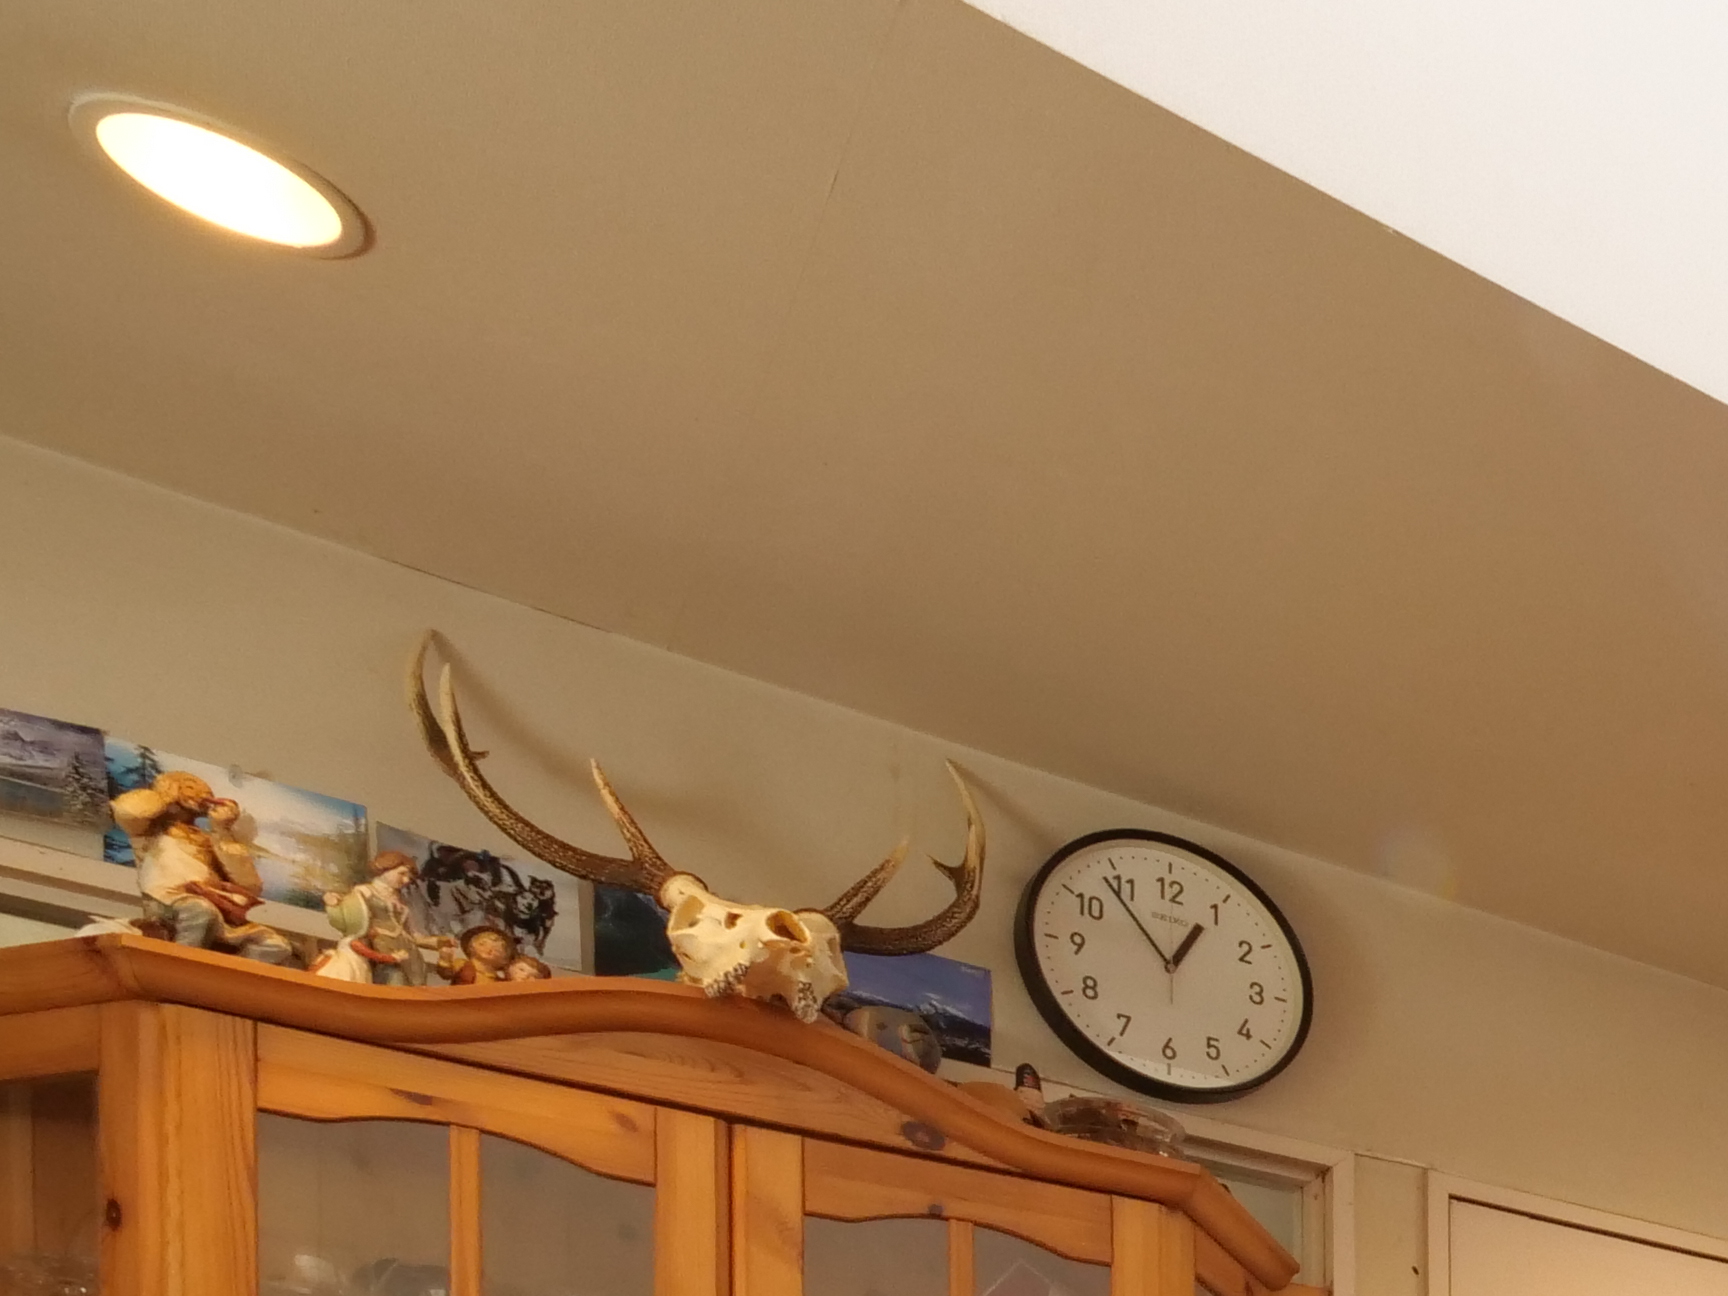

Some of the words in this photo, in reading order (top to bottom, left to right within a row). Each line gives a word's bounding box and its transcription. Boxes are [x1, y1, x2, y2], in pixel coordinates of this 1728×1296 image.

[1112, 875, 1135, 901] 11
[1156, 877, 1184, 906] 12
[1076, 892, 1104, 920] 10
[1210, 903, 1219, 926] 1
[1070, 932, 1085, 955] 9
[1238, 941, 1253, 964] 2
[1082, 976, 1099, 1000] 8
[1249, 982, 1264, 1005] 3
[1117, 1013, 1132, 1037] 7
[1237, 1018, 1252, 1041] 4
[1162, 1038, 1177, 1060] 6
[1206, 1037, 1221, 1061] 5
